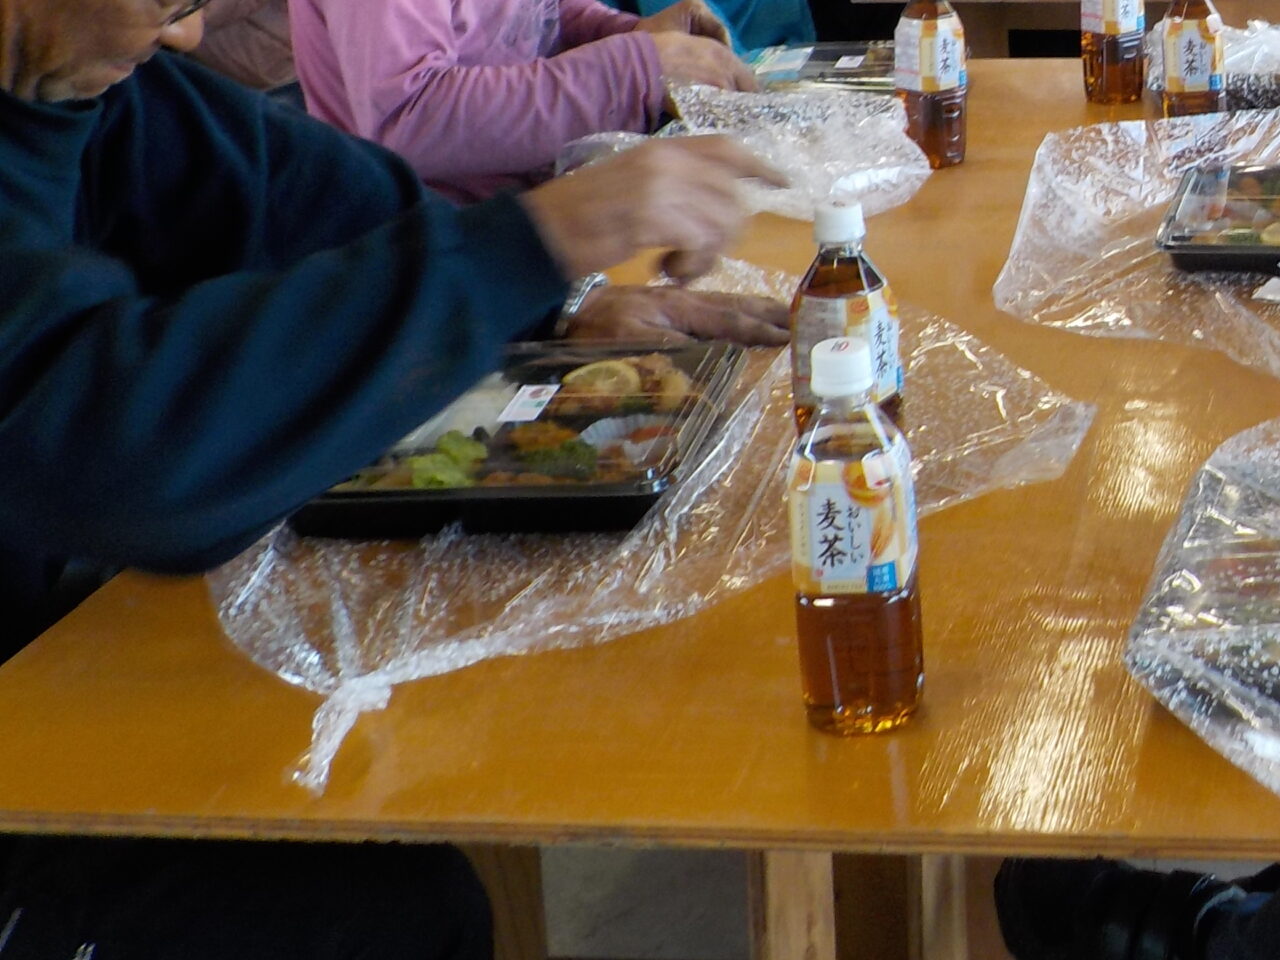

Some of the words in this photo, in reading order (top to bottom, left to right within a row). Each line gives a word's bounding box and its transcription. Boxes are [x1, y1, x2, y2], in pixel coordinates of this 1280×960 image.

[816, 497, 848, 569] 麦茶
[846, 504, 865, 564] おいしい
